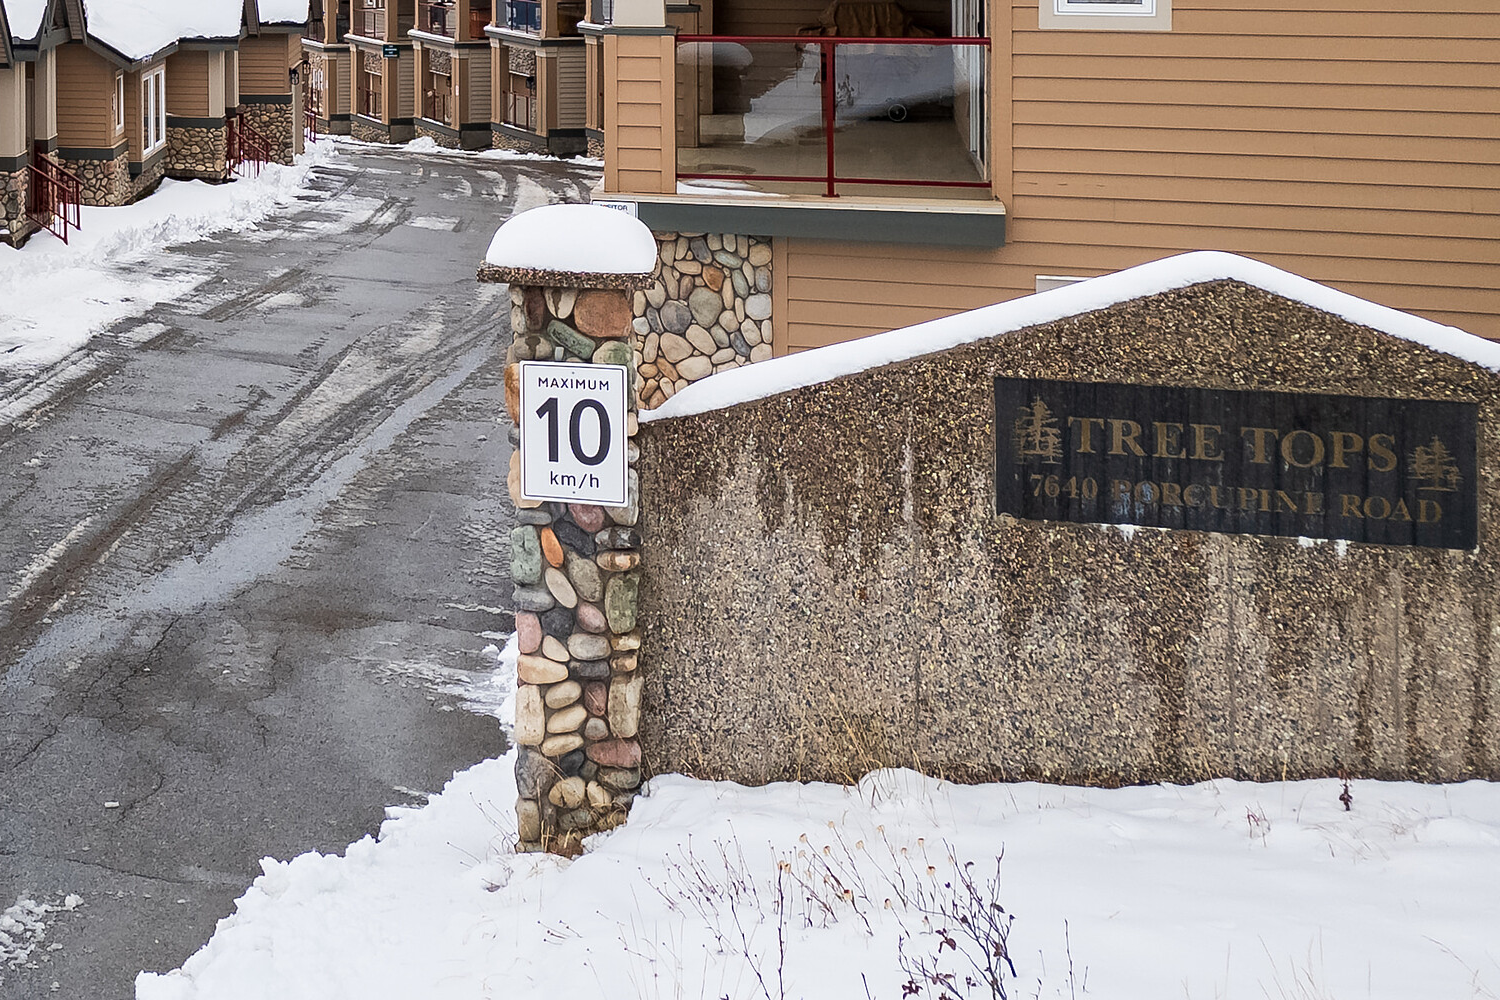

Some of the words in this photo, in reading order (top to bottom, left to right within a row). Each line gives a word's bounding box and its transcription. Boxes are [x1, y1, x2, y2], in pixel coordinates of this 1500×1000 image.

[538, 377, 610, 391] MAXIMUM
[535, 397, 611, 466] 10
[1067, 416, 1225, 462] TREE
[1240, 426, 1399, 472] TOPS
[550, 471, 599, 489] km/h
[1029, 474, 1099, 500] 7640
[1111, 479, 1325, 515] PORCUPINE
[1341, 494, 1443, 524] ROAD
